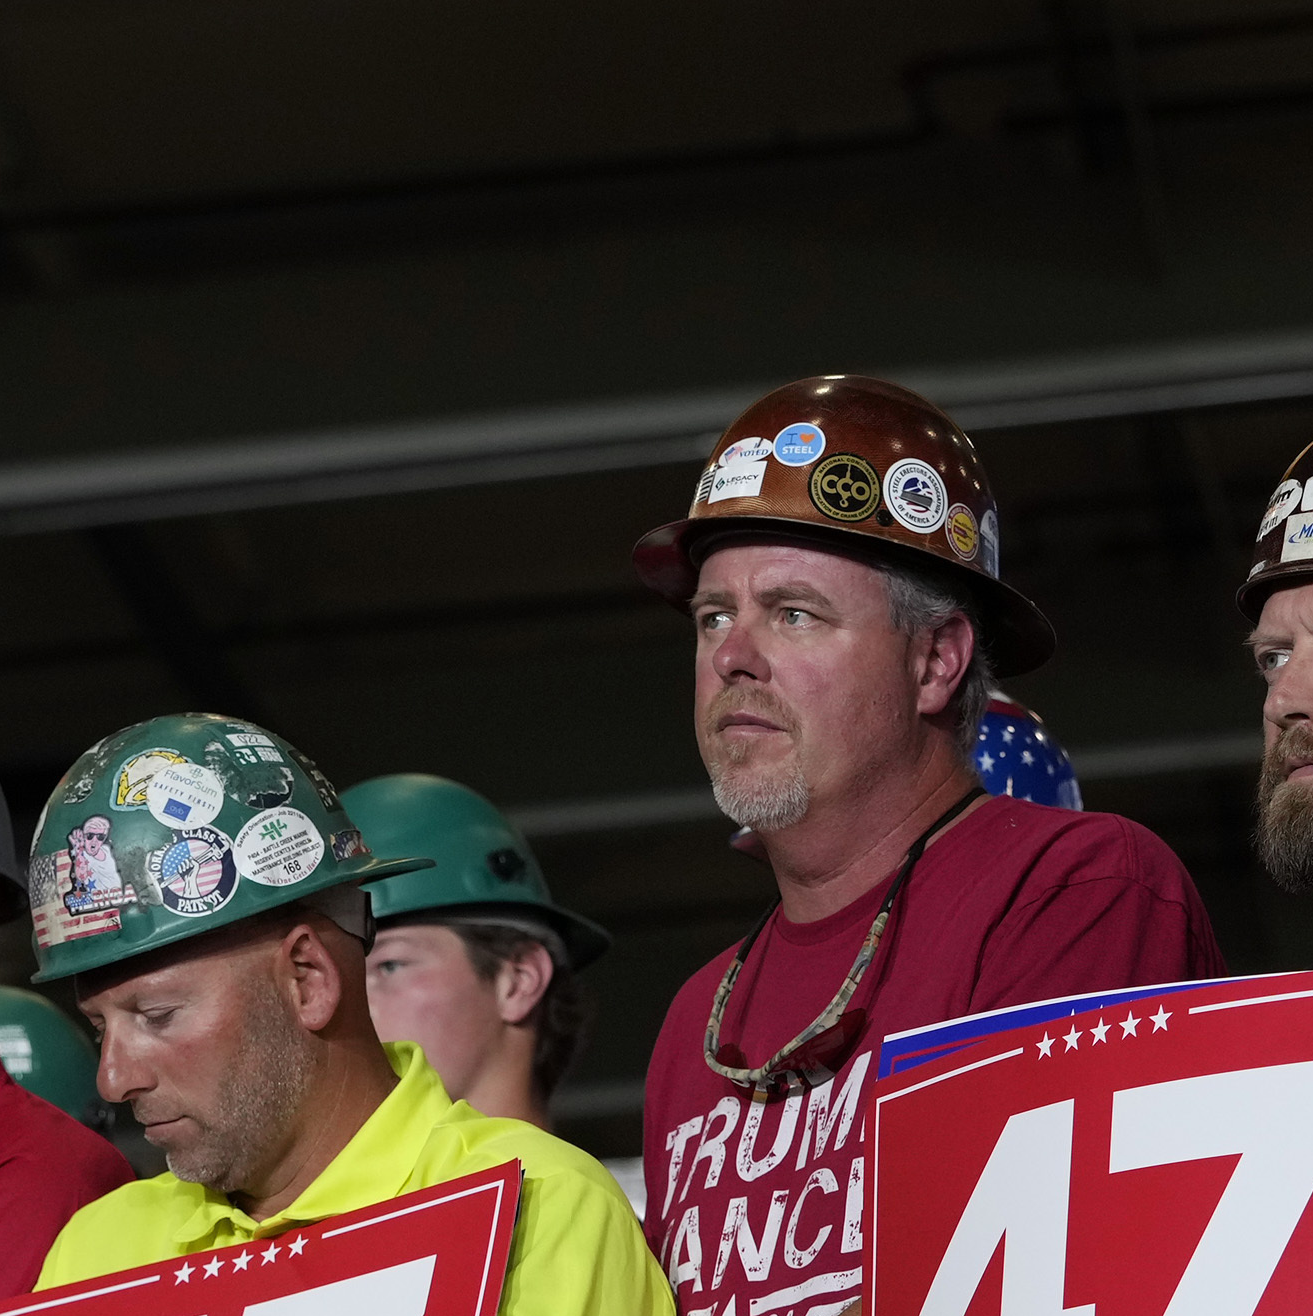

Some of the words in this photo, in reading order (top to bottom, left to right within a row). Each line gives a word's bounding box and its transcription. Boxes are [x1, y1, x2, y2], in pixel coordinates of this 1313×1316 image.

[782, 446, 814, 454] STEEL
[785, 433, 798, 446] I
[739, 448, 769, 458] VOTED
[726, 474, 759, 484] LEGACY
[818, 458, 845, 474] NATIONAL
[847, 457, 876, 485] COMMISSION
[822, 473, 871, 502] CCO
[892, 476, 901, 494] STEEL
[899, 467, 928, 477] ERECTORS
[927, 475, 942, 515] ASSOCIATION
[897, 504, 905, 512] OF
[904, 512, 931, 524] AMERICA
[164, 768, 218, 798] FlavorSum
[153, 781, 184, 797] SAFETY
[187, 794, 216, 812] FIRST!
[181, 829, 217, 843] CLASS
[236, 830, 250, 848] Safety
[248, 811, 274, 831] Orientation
[262, 841, 280, 854] BATTLE
[279, 836, 294, 847] CREEK
[292, 829, 309, 841] MARINE
[251, 858, 284, 877] MAINTENANCE
[283, 850, 303, 862] BUILDING
[301, 841, 322, 856] PROJECT
[253, 853, 276, 867] RESERVE
[273, 845, 292, 858] CENTER
[282, 859, 302, 876] 168
[276, 877, 292, 885] One
[292, 869, 308, 881] Gets
[661, 1050, 865, 1221] TRUM
